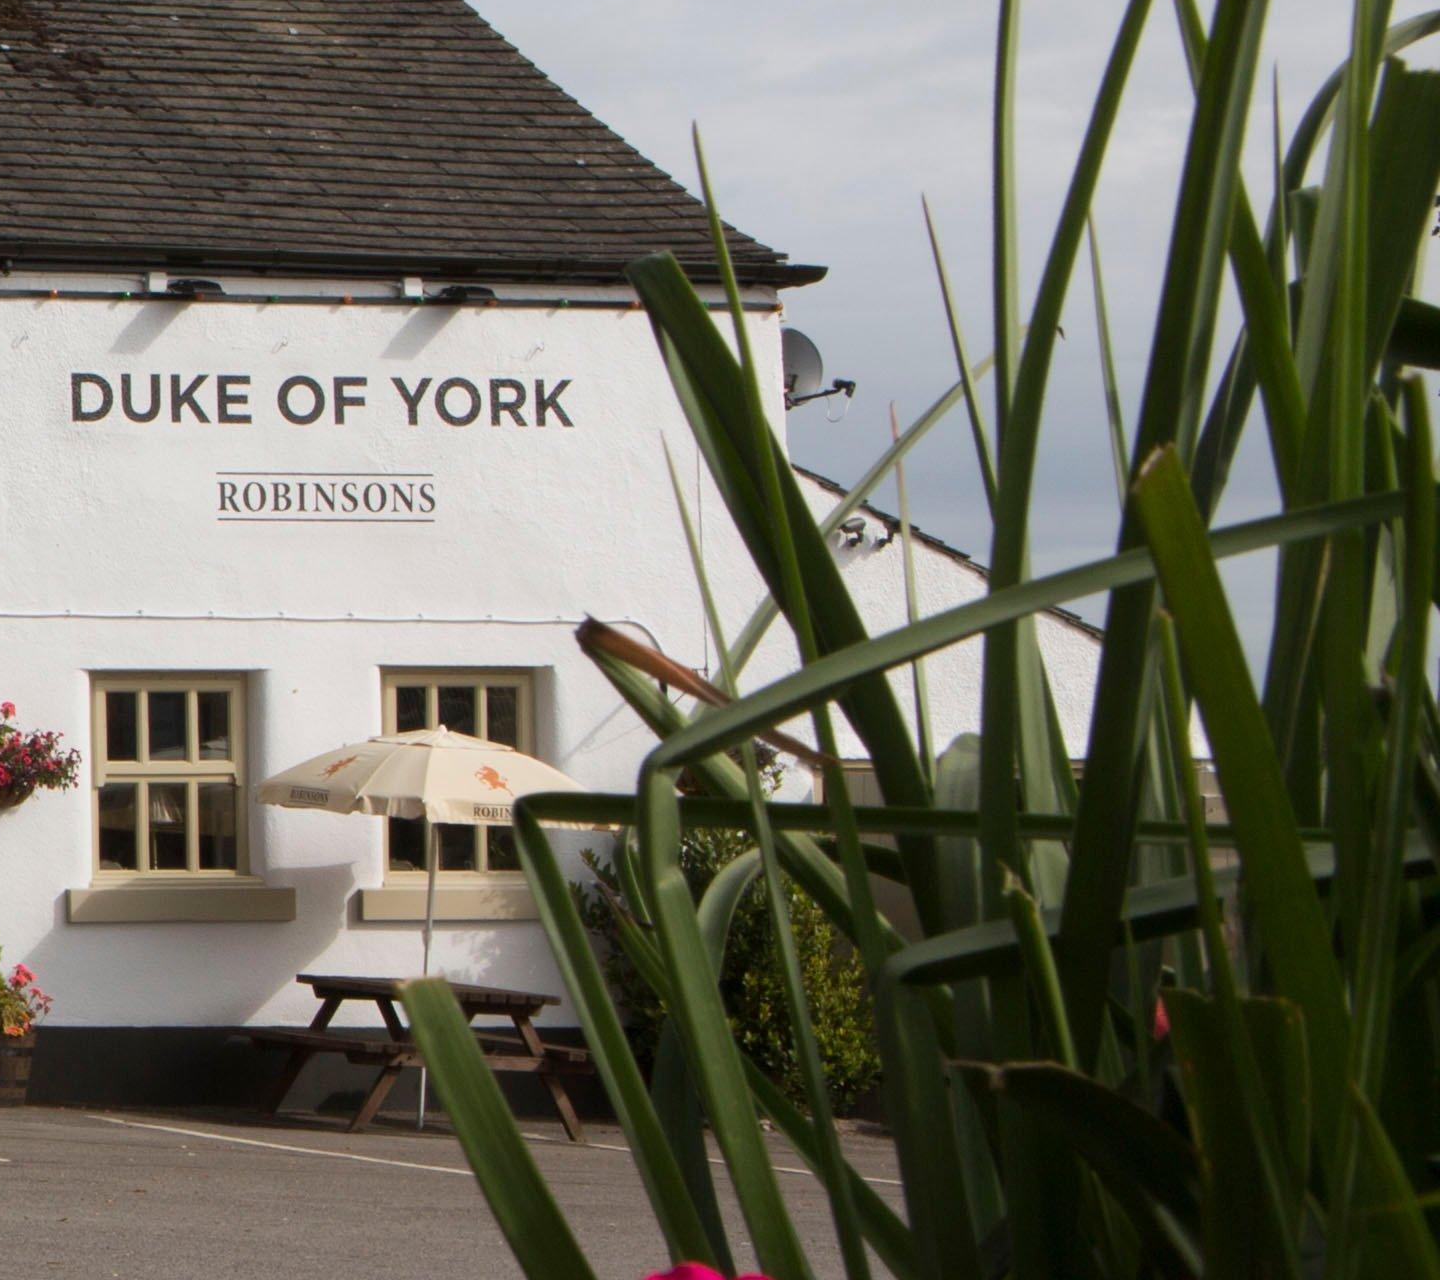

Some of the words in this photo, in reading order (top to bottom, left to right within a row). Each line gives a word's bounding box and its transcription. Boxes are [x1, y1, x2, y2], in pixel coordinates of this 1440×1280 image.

[71, 373, 252, 424] DUKE
[277, 375, 368, 425] OF
[391, 377, 574, 428] YORK
[217, 482, 436, 513] ROBINSONS
